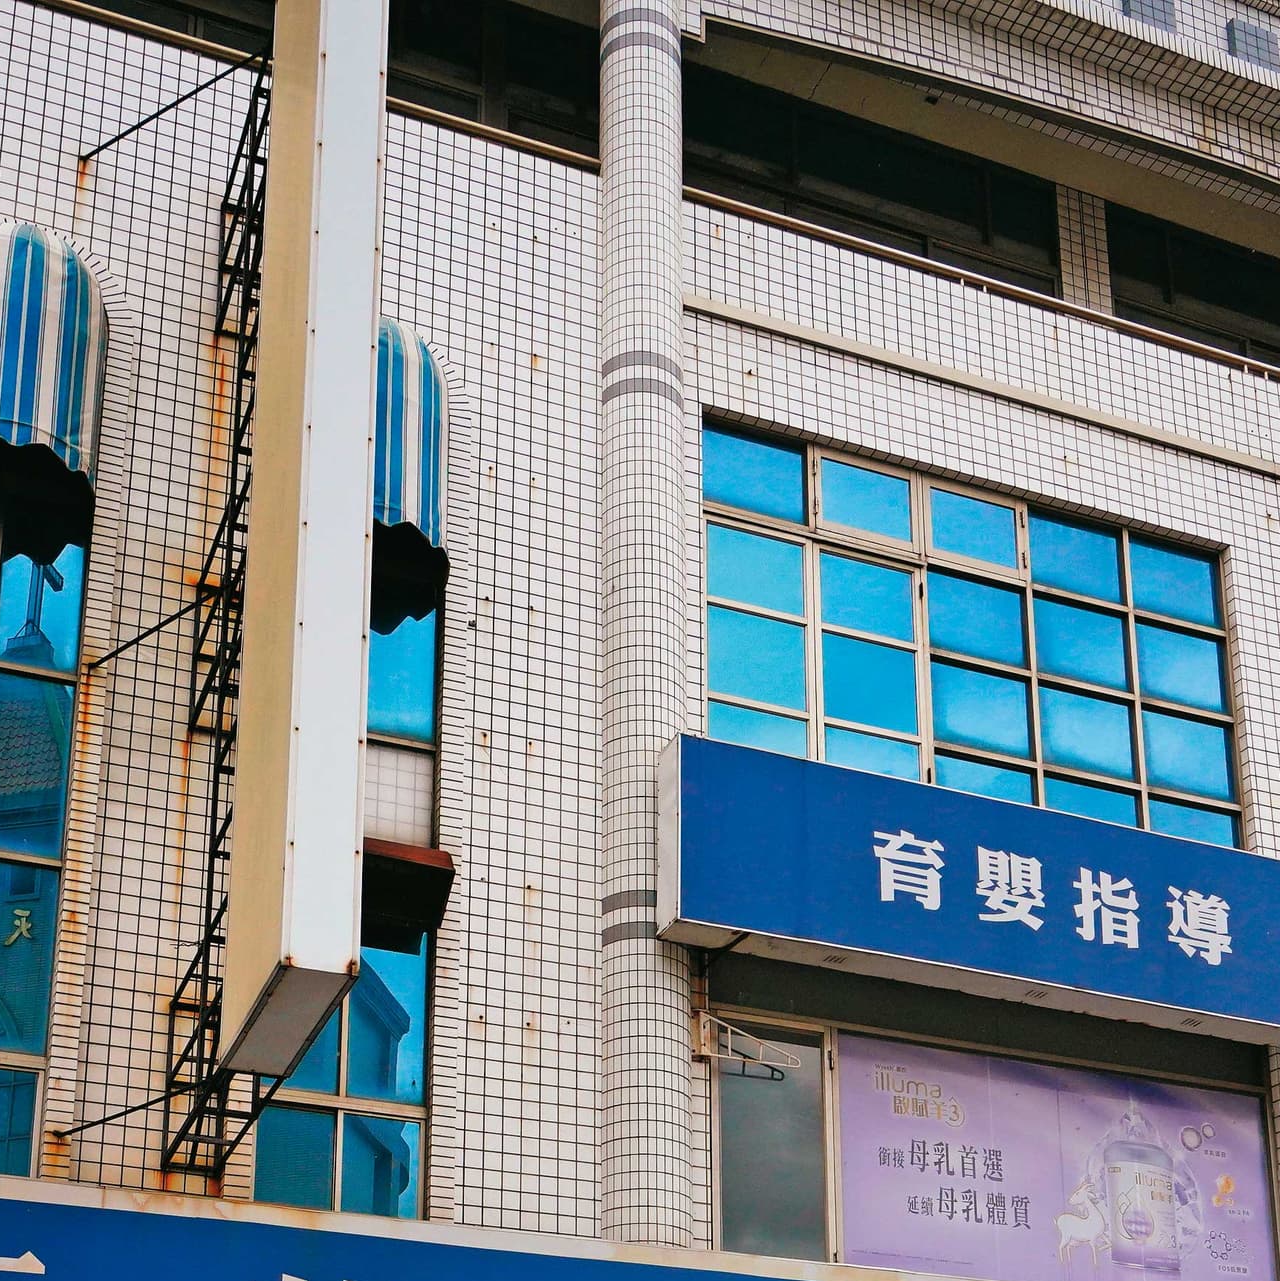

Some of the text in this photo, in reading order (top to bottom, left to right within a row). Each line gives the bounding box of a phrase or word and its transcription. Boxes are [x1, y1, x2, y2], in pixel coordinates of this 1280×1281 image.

[872, 828, 1233, 967] 育嬰指導
[875, 1072, 942, 1099] illuma
